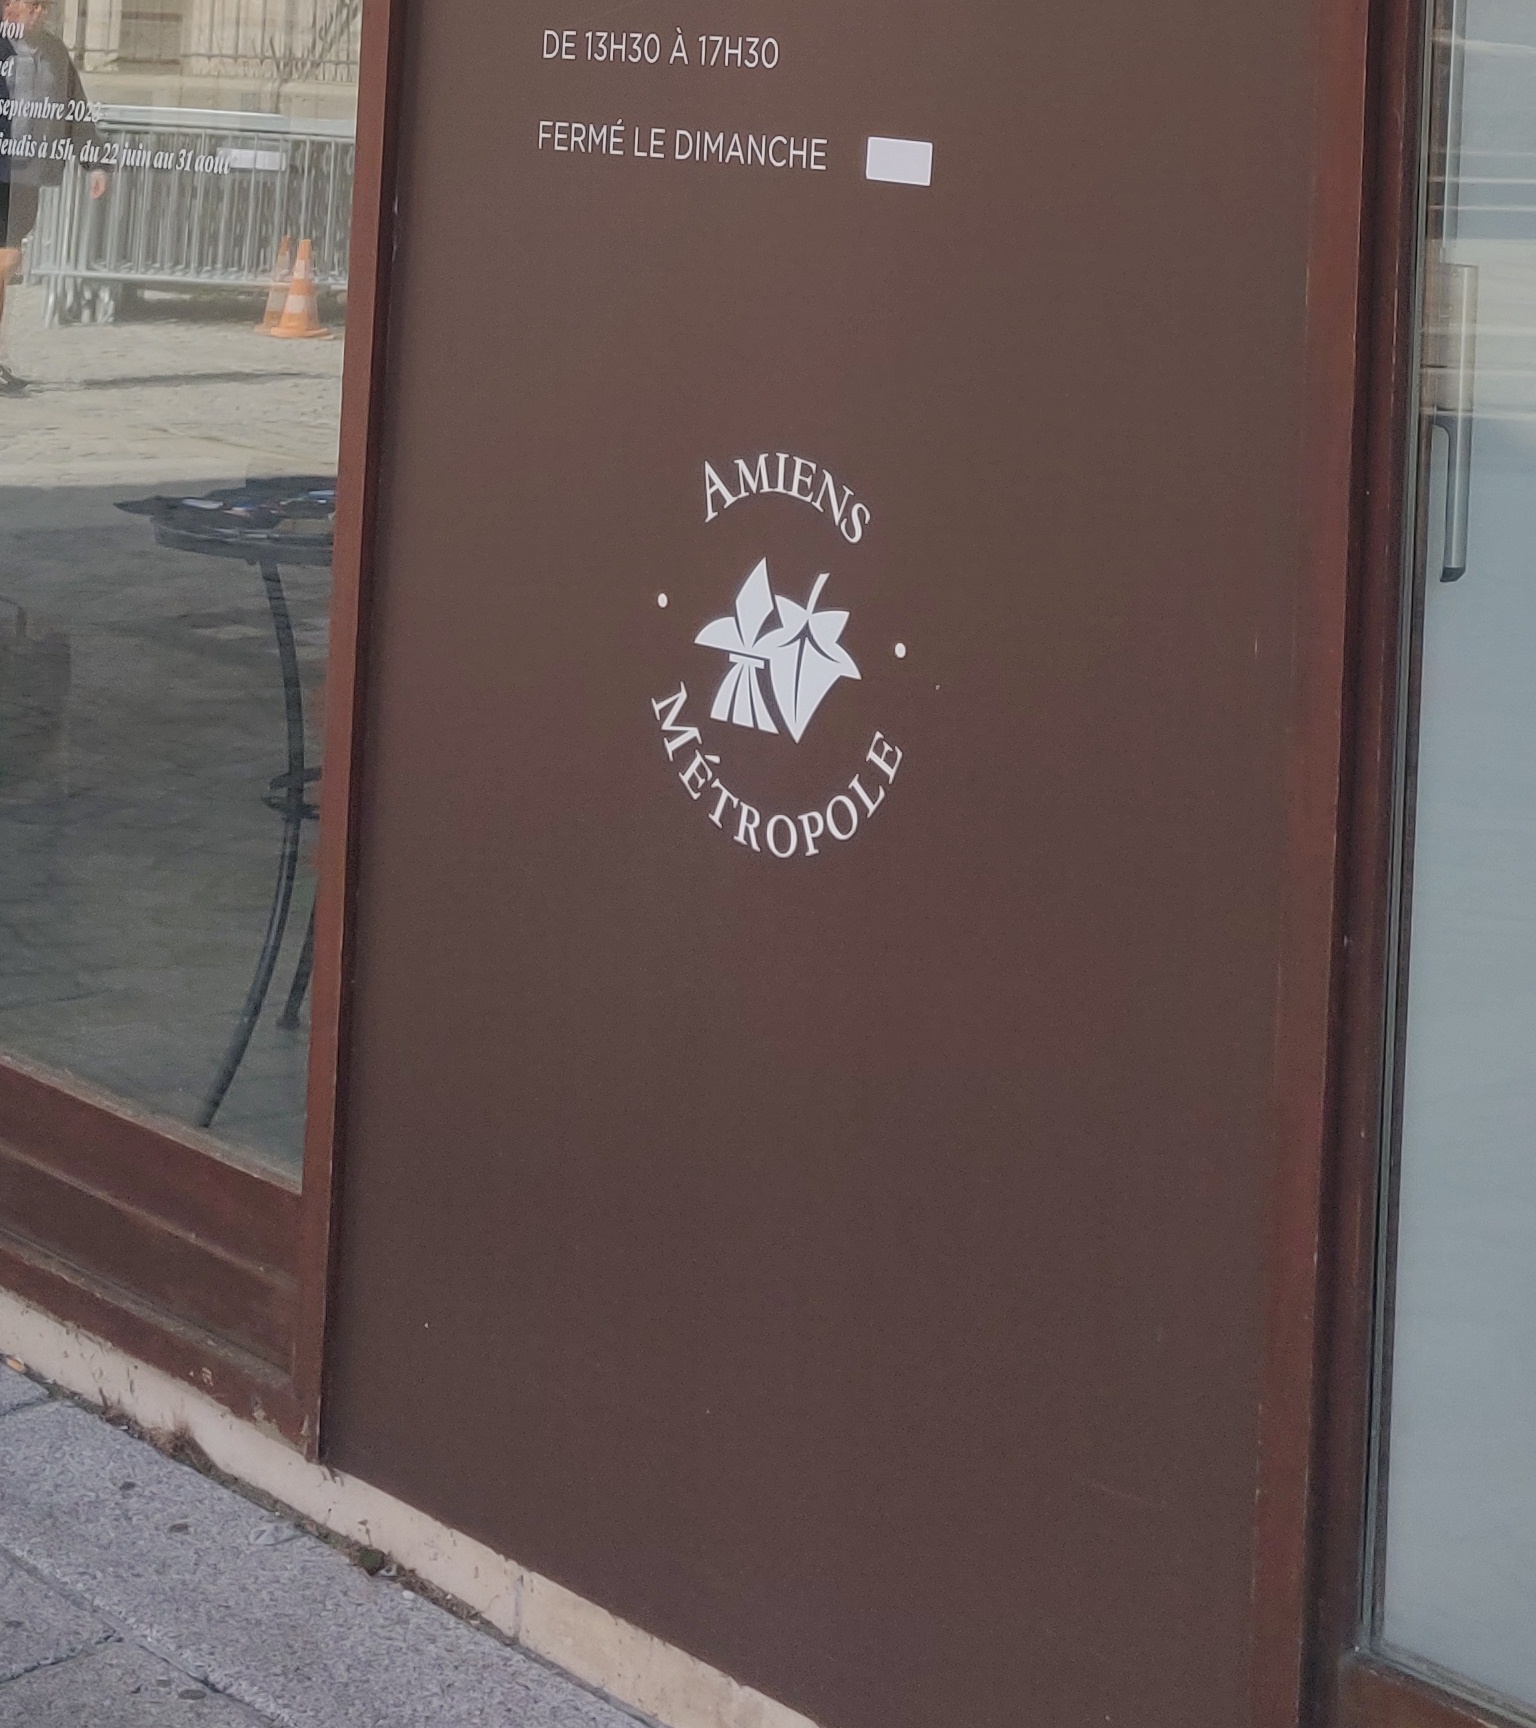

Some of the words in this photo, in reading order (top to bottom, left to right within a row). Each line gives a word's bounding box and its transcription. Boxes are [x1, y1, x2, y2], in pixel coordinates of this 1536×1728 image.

[542, 29, 576, 60] DE
[585, 31, 661, 64] 13H30
[669, 27, 689, 65] À
[698, 35, 780, 69] 17H30
[38, 134, 48, 160] à
[79, 139, 101, 163] du
[100, 142, 118, 165] 22
[120, 141, 152, 169] juin
[153, 150, 176, 170] au
[176, 148, 194, 172] 31
[538, 118, 625, 157] FERMÉ
[633, 126, 666, 159] LE
[674, 129, 829, 171] DIMANCHE
[704, 452, 871, 543] AMIENS
[651, 680, 904, 858] MÉTROPOLE
